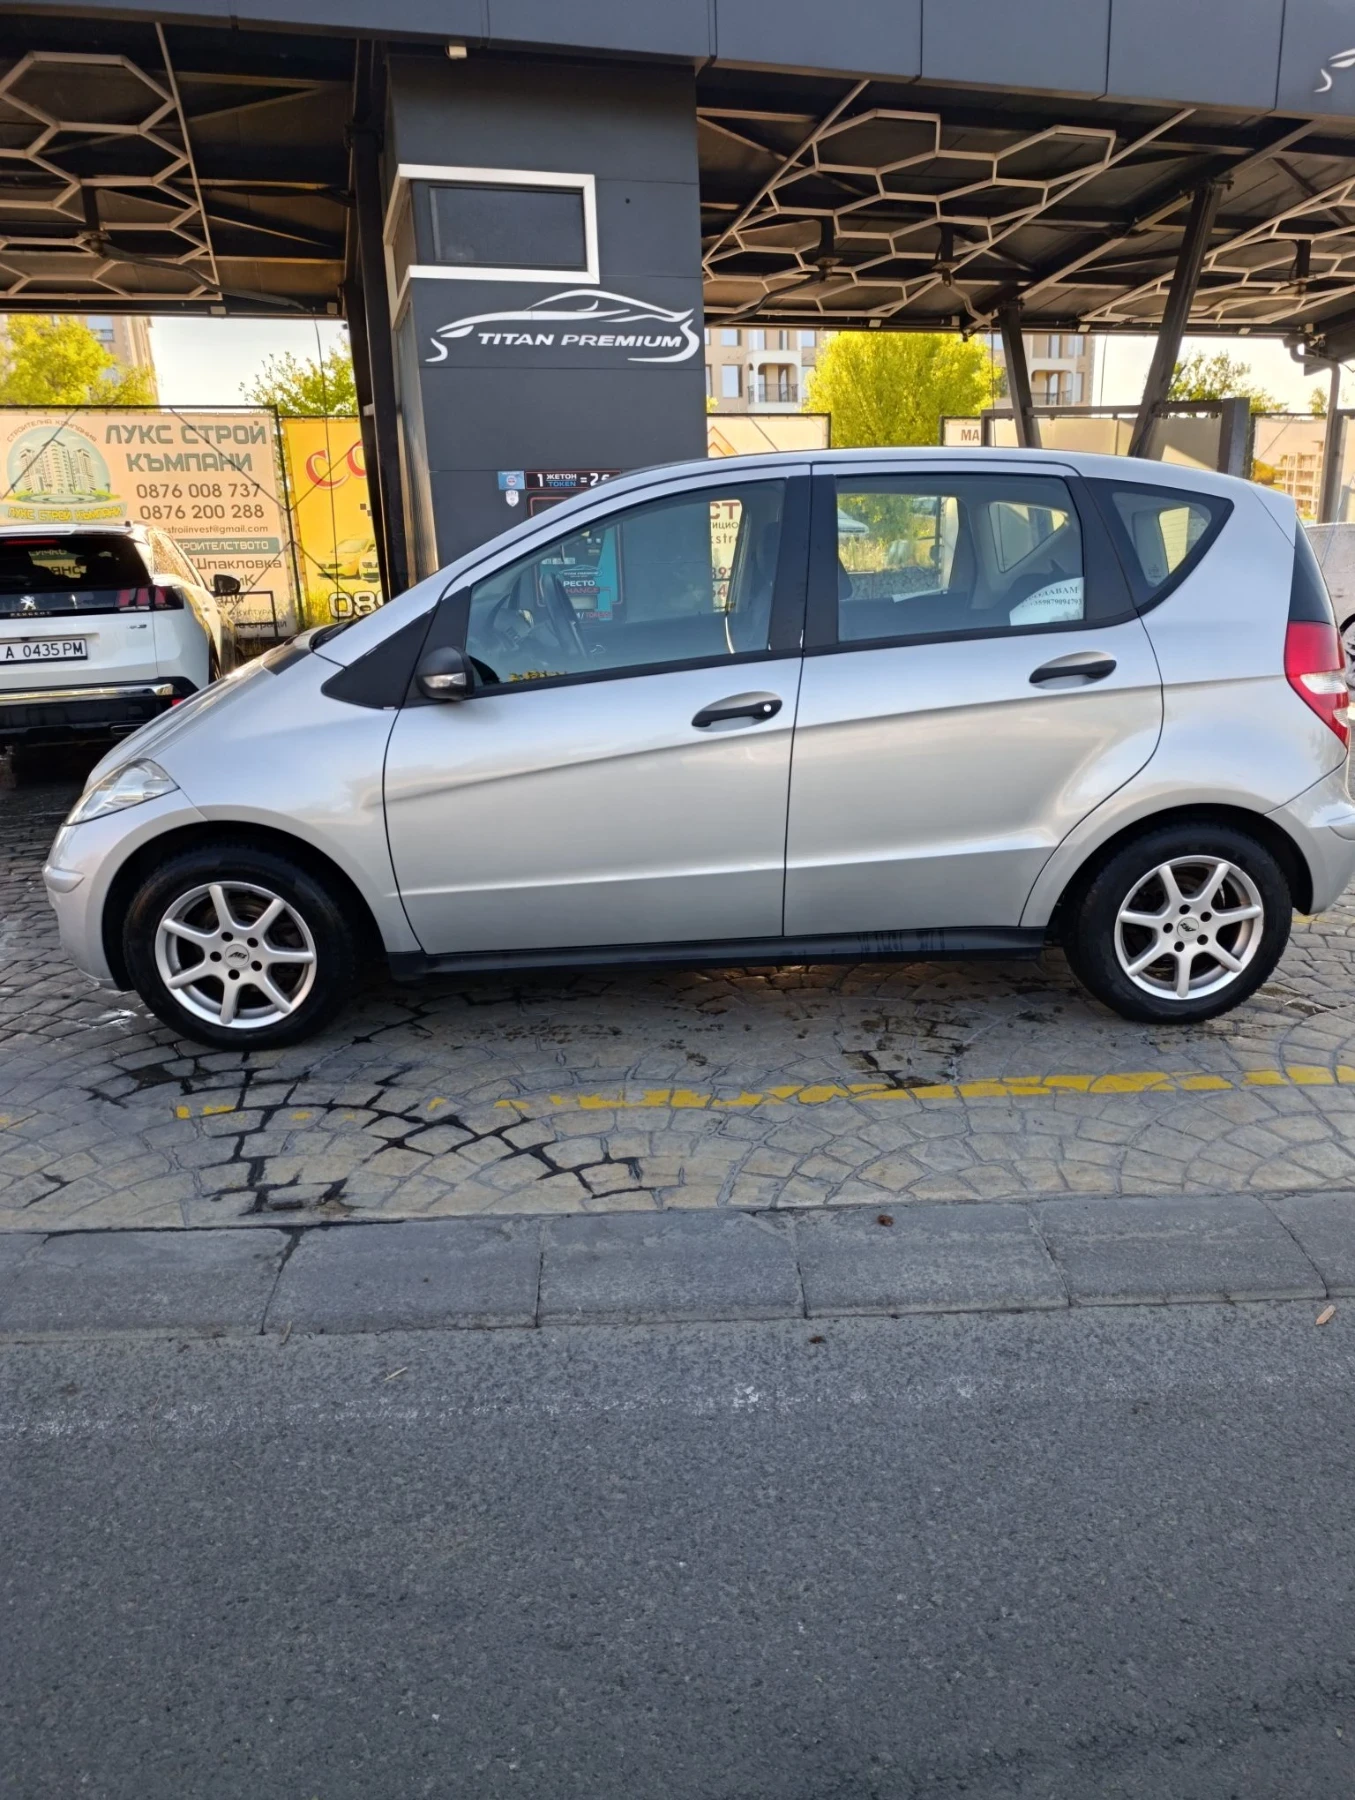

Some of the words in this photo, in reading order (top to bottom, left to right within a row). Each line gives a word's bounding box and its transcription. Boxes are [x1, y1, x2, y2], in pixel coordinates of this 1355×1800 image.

[477, 332, 554, 346] TITAN
[561, 334, 682, 348] PREMIUM
[105, 424, 174, 444] ЛУКС
[180, 420, 267, 444] СТРОЙ
[126, 452, 253, 472] КЪМПАНИ
[537, 473, 544, 487] 1
[136, 483, 182, 498] 0876
[188, 483, 222, 498] 008
[228, 483, 260, 498] 737
[139, 505, 186, 520] 0876
[191, 504, 225, 519] 200
[231, 504, 264, 519] 288
[22, 642, 60, 658] 0435
[62, 641, 84, 656] PM
